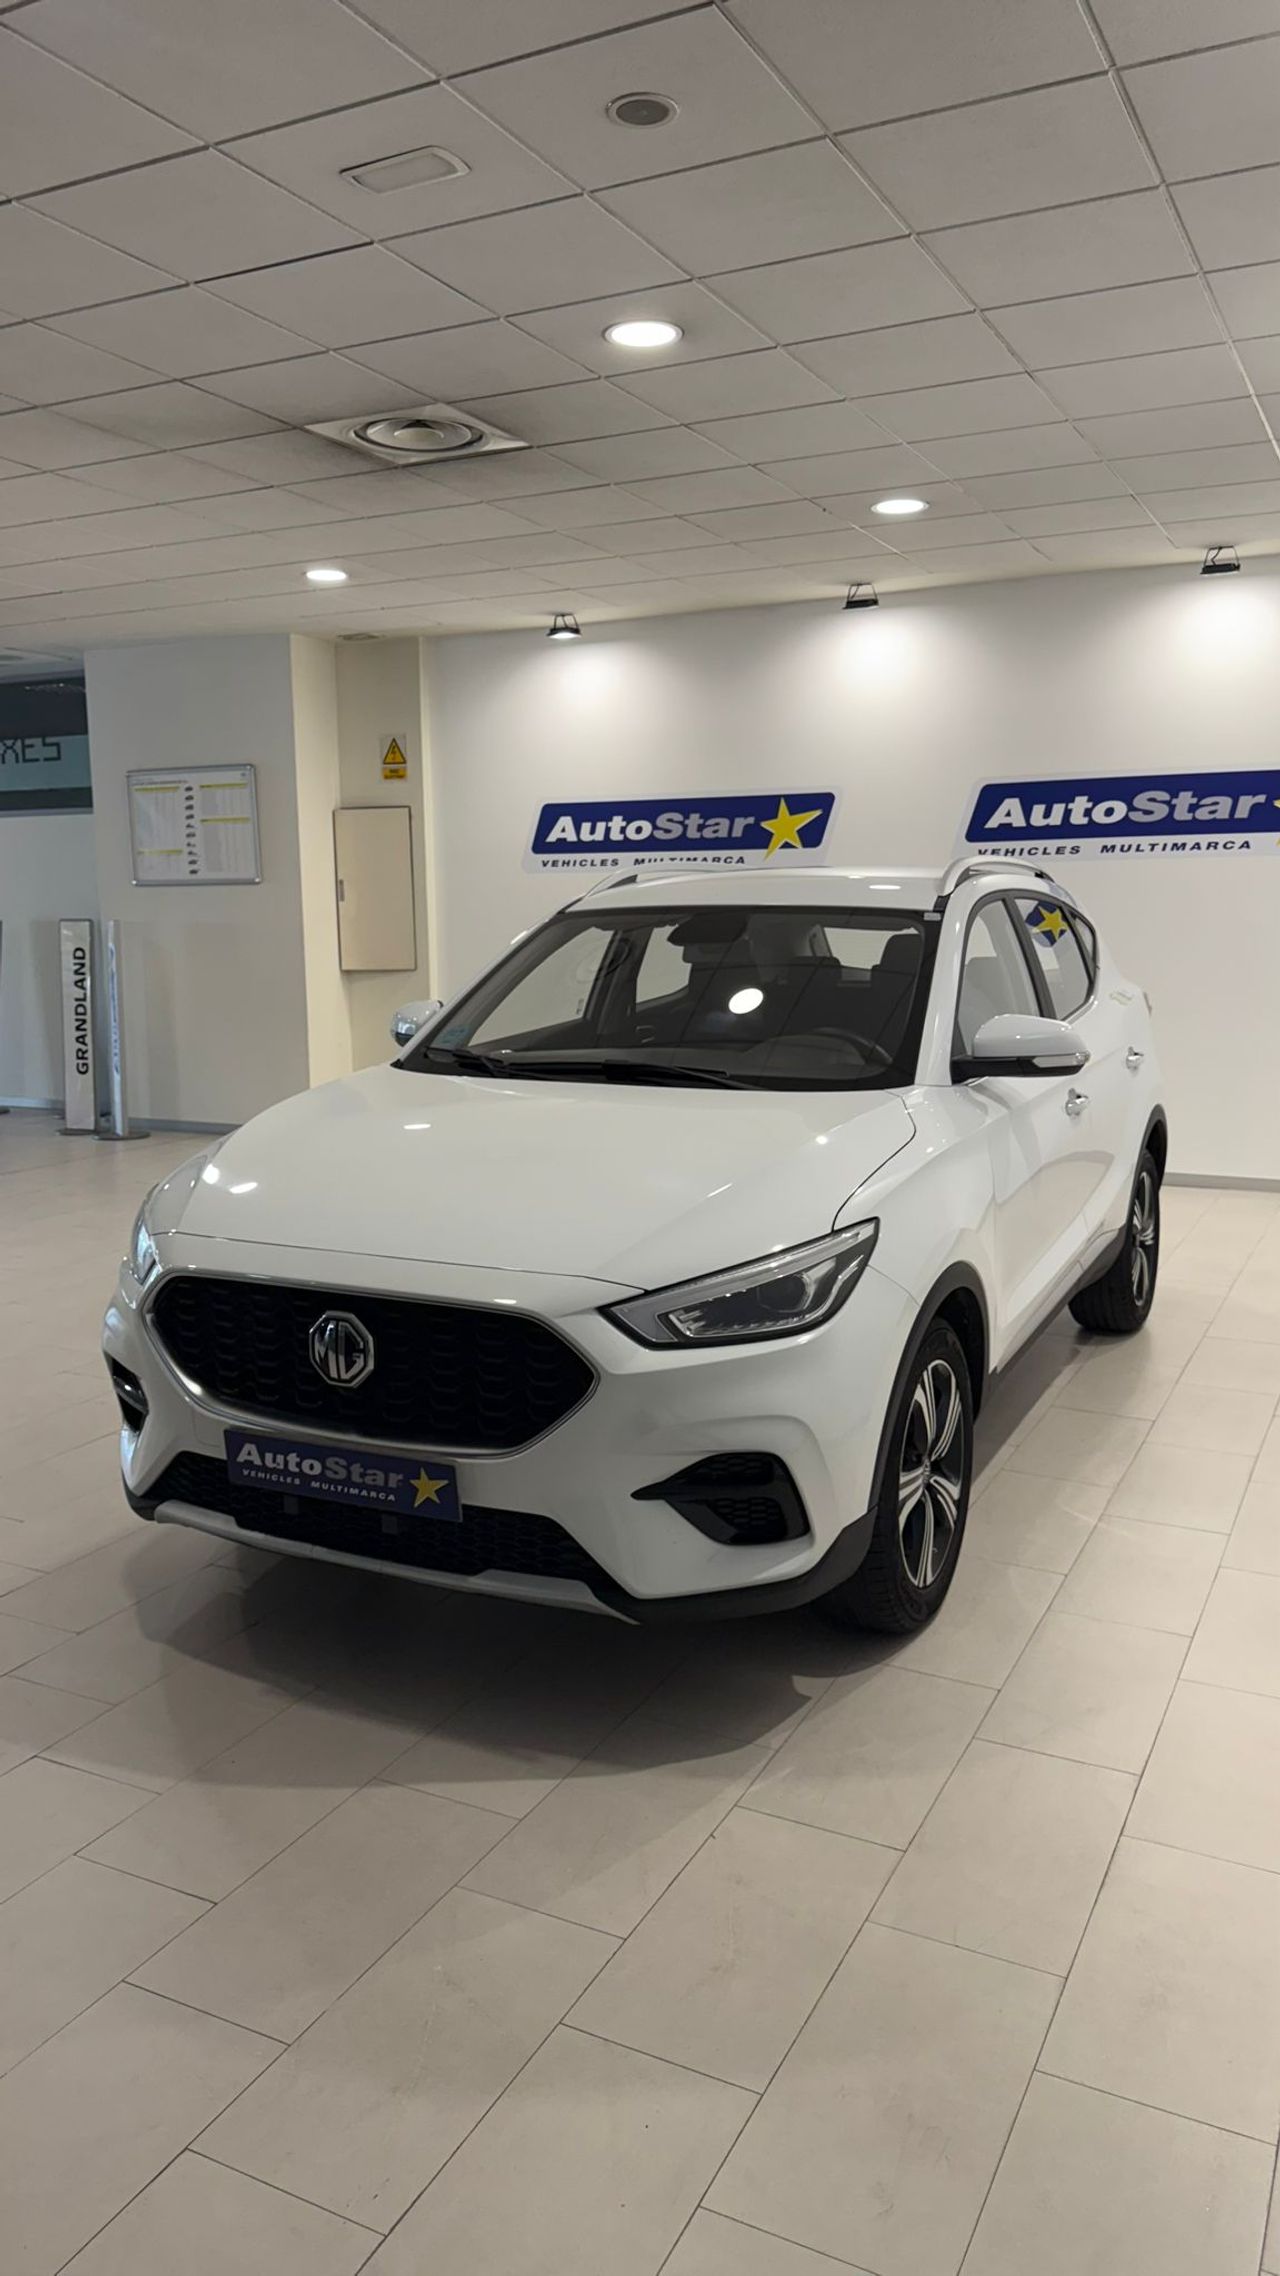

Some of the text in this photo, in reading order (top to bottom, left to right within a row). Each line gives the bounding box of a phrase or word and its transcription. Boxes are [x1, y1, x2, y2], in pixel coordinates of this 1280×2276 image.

[545, 811, 754, 843] AutoStar
[983, 790, 1267, 829] AutoStar
[541, 858, 619, 868] VEHICLES
[977, 840, 1251, 857] VEHICLES MULTIMARCA
[72, 946, 89, 1075] GRANDLAND
[314, 1319, 365, 1380] MG
[236, 1442, 404, 1489] AutoStar
[241, 1468, 397, 1501] VEHICLES MULTIMARCA
